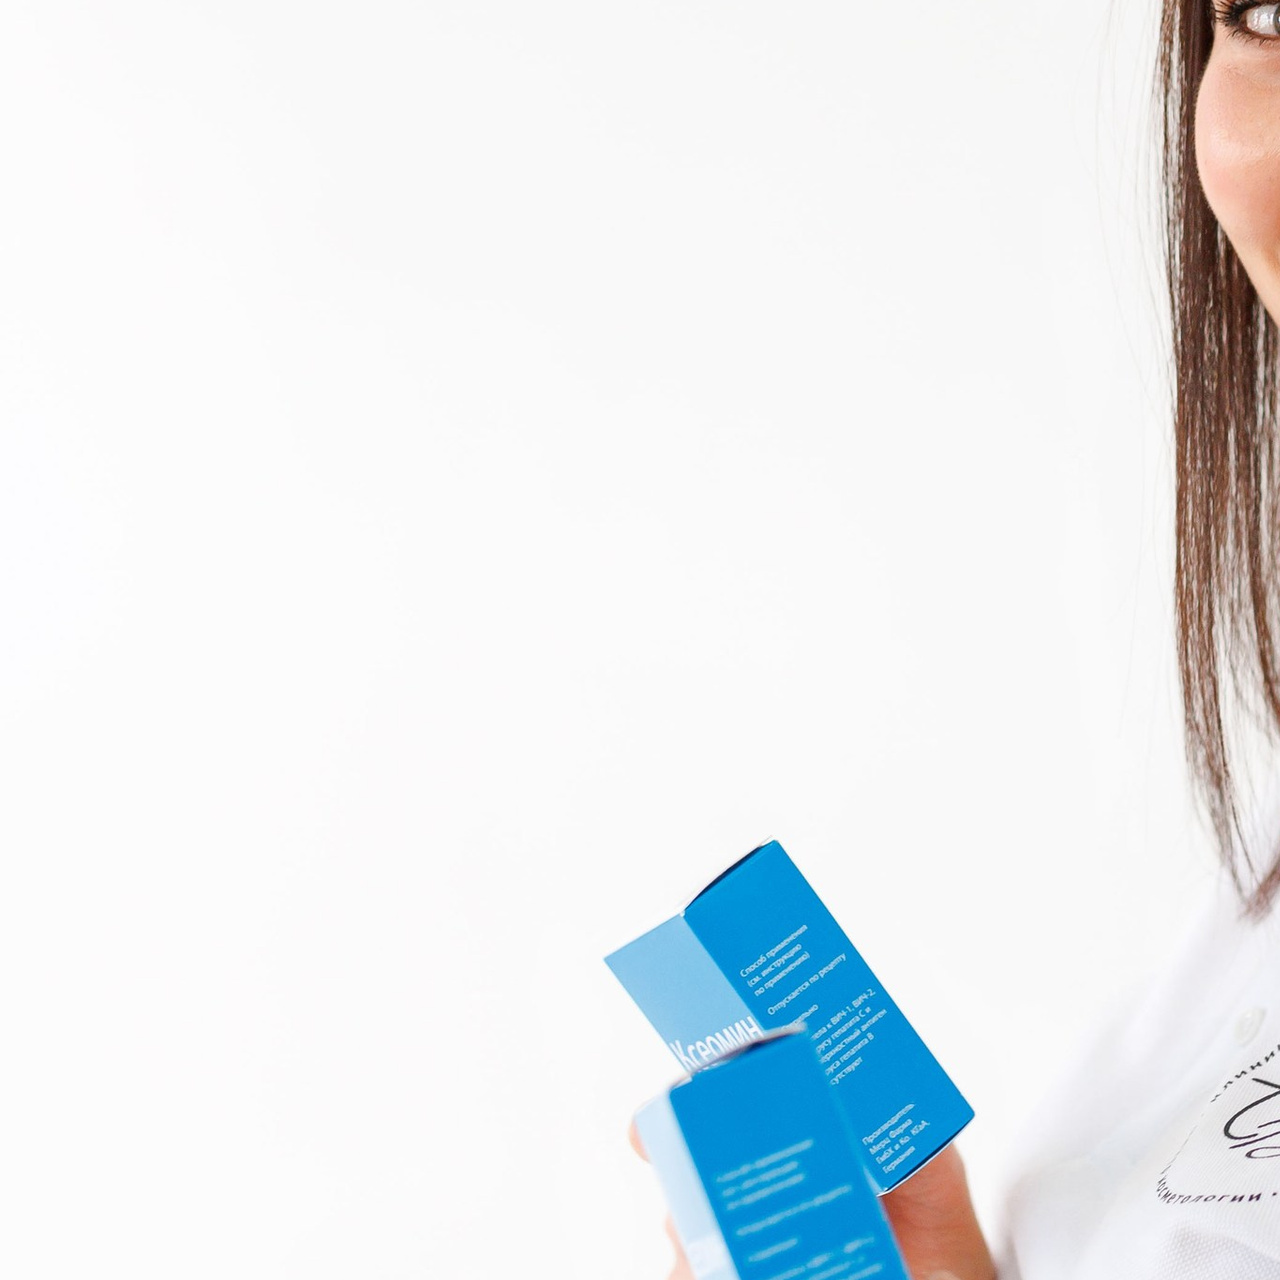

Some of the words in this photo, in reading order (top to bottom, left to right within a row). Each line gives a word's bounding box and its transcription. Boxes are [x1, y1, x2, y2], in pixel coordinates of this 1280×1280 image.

[740, 953, 767, 977] Способ
[754, 986, 765, 997] по
[767, 980, 811, 1015] Отпускается
[808, 973, 820, 984] по
[817, 952, 846, 978] рецепту
[669, 1015, 765, 1073] Ксеомин
[815, 1037, 832, 1055] русу
[824, 1060, 841, 1076] руса
[829, 1055, 863, 1086] сутствуют
